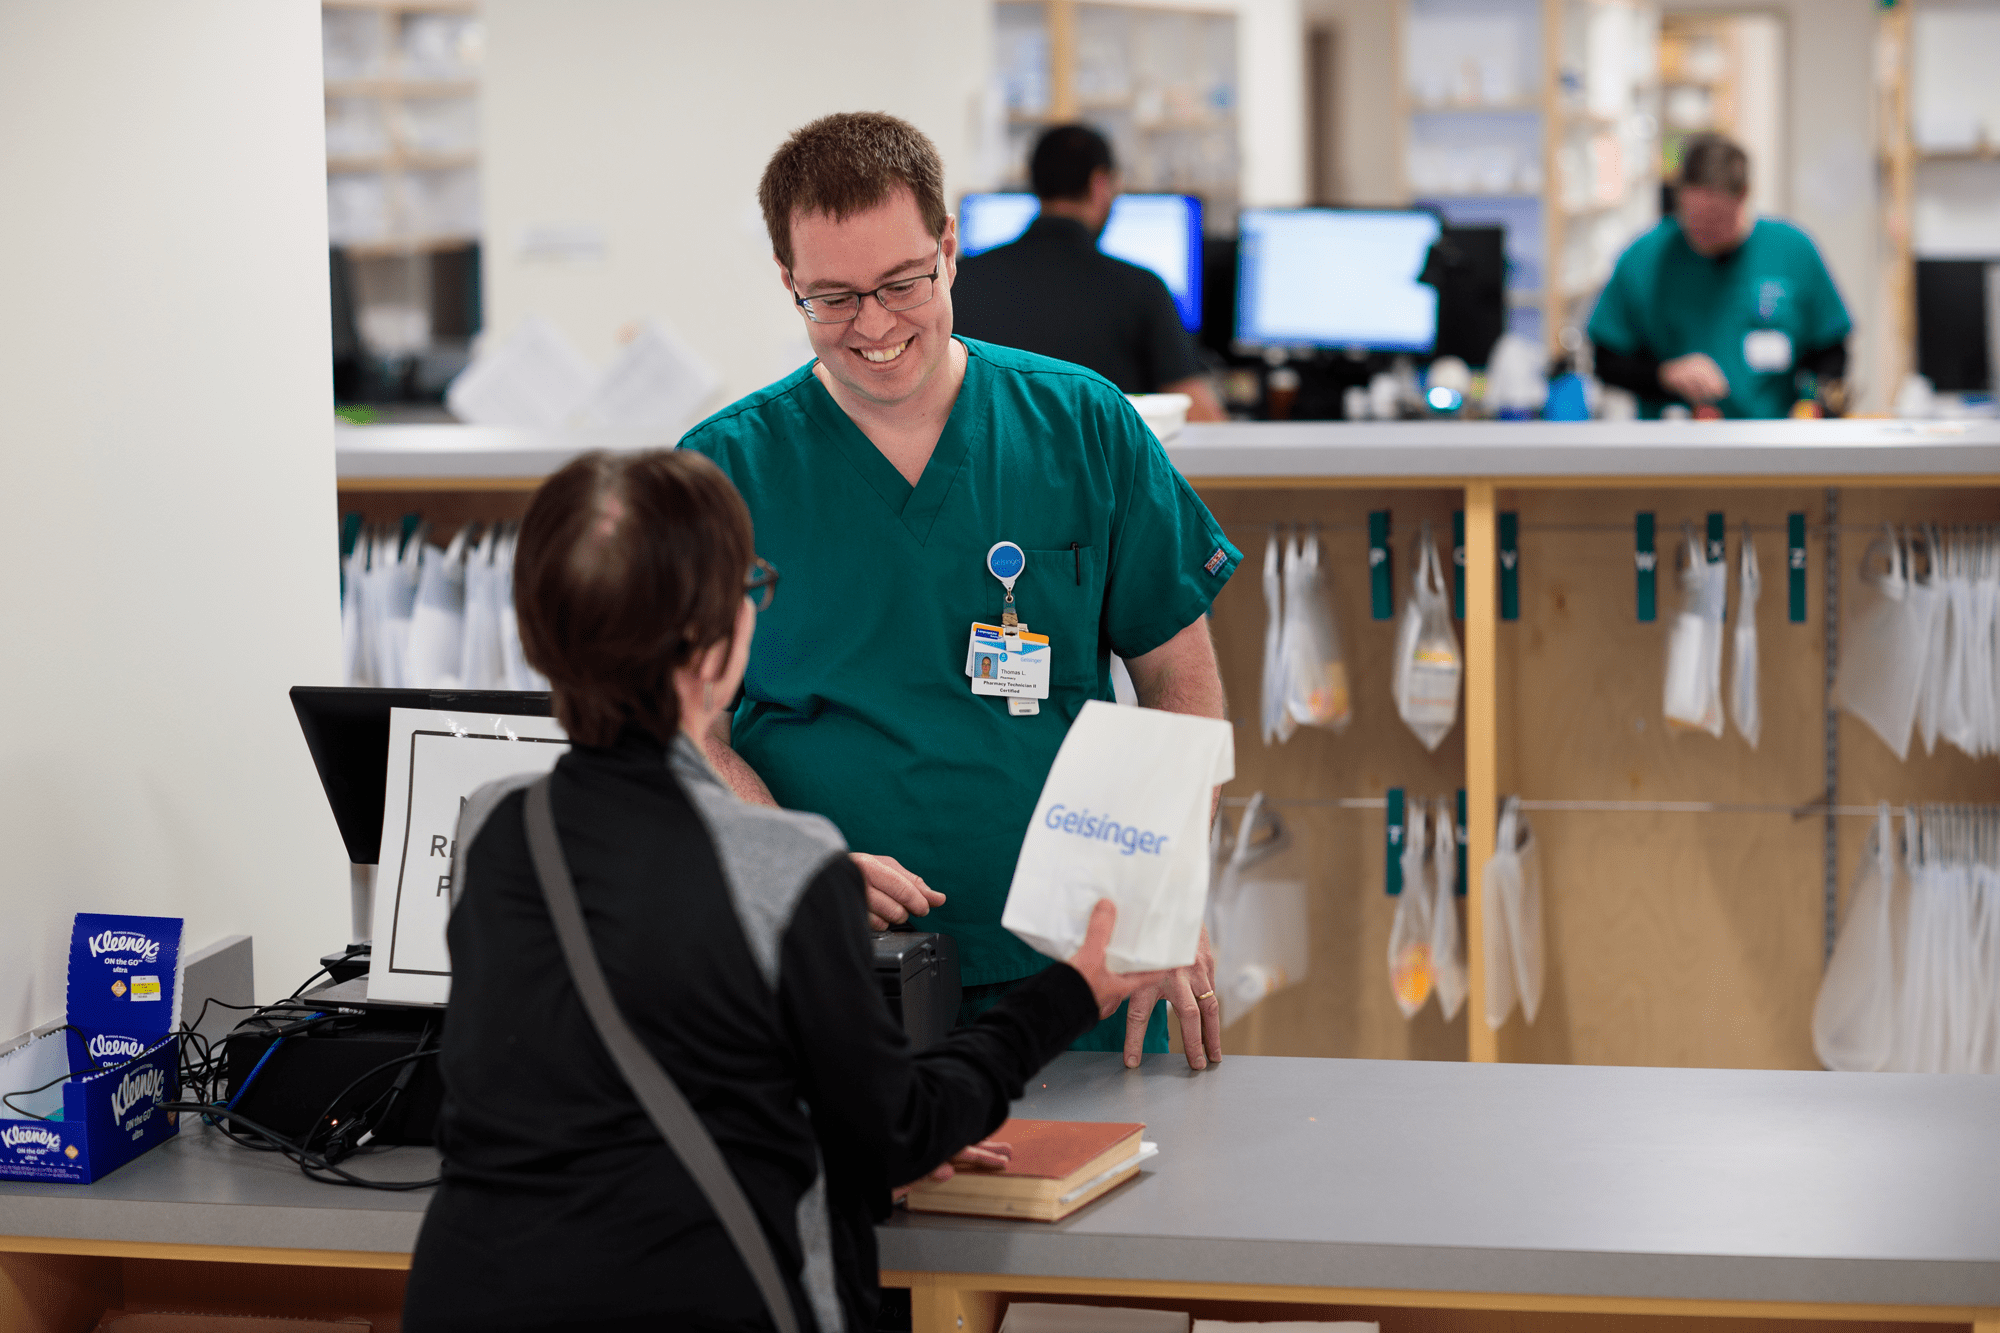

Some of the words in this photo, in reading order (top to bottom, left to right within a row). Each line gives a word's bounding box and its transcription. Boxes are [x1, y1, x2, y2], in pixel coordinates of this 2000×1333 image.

[1001, 668, 1021, 676] Thomas
[1045, 803, 1169, 856] Geisinger
[88, 930, 160, 959] Kleenex
[104, 957, 116, 965] ON
[116, 958, 128, 966] the
[112, 966, 128, 974] ultra
[111, 1069, 164, 1126] Kleenex
[1, 1125, 60, 1149] Kleenex
